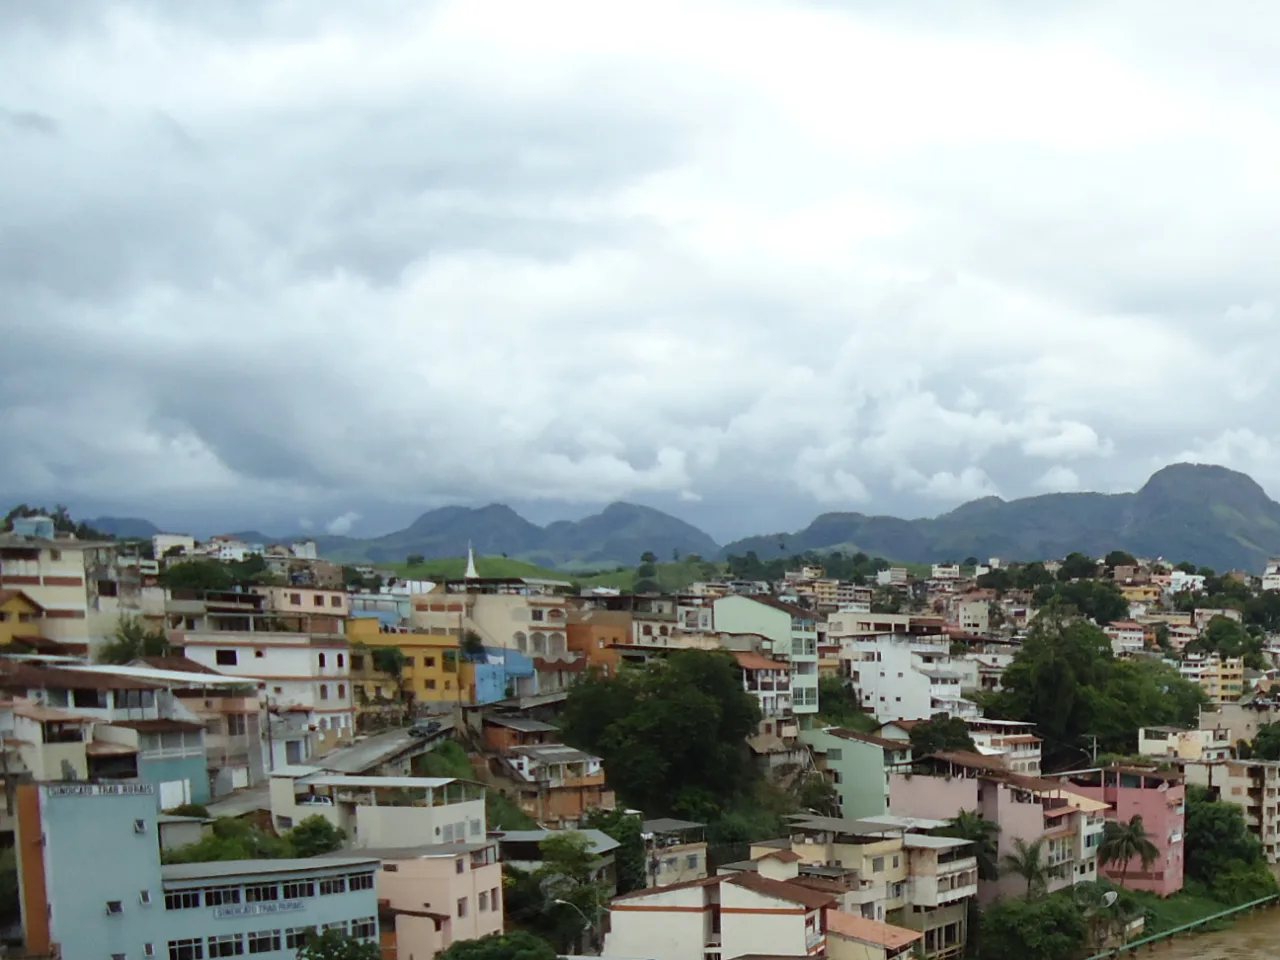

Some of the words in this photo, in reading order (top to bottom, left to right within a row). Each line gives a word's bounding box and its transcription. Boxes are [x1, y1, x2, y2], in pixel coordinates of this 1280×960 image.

[50, 785, 93, 796] SINDICATO
[98, 785, 119, 795] TRAB
[122, 784, 152, 795] RURAIS
[217, 905, 256, 917] SINDICATO
